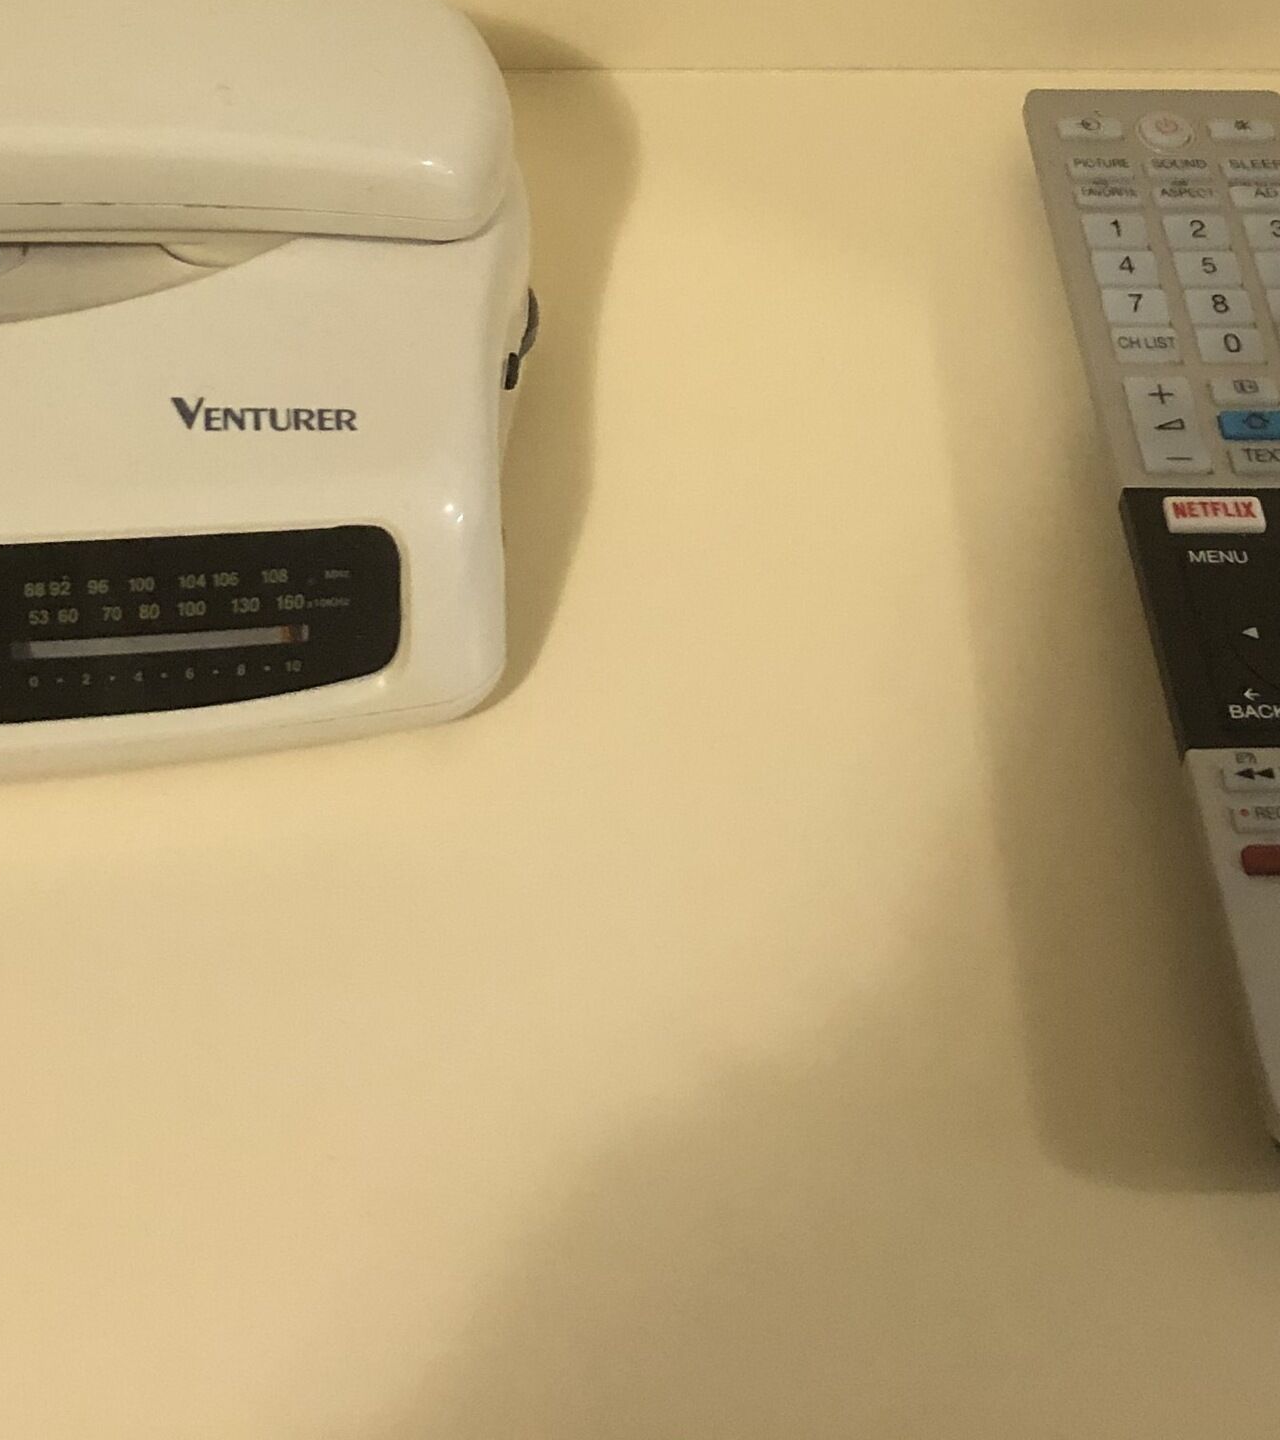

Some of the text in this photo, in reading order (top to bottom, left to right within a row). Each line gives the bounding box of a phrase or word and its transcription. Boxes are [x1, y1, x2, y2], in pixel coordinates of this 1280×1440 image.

[1072, 158, 1130, 169] PICTURE
[1150, 158, 1208, 169] SOUND
[1110, 220, 1122, 237] 1
[1189, 219, 1207, 238] 2
[1118, 256, 1136, 273] 4
[1201, 256, 1218, 275] 5
[1127, 293, 1145, 312] 7
[1211, 293, 1230, 313] 8
[1117, 335, 1176, 349] CH LIST
[1223, 332, 1242, 353] 0
[170, 396, 358, 432] VENTURER
[1172, 500, 1257, 519] NETFLIX
[1187, 549, 1249, 564] MENU
[49, 579, 72, 597] 92
[127, 576, 156, 593] 100
[178, 573, 207, 589] 104
[27, 609, 50, 626] 53
[56, 607, 79, 624] 60
[101, 606, 123, 622] 70
[138, 602, 160, 620] 80
[176, 600, 207, 617] 100
[231, 597, 261, 614] 130
[82, 672, 92, 686] 2
